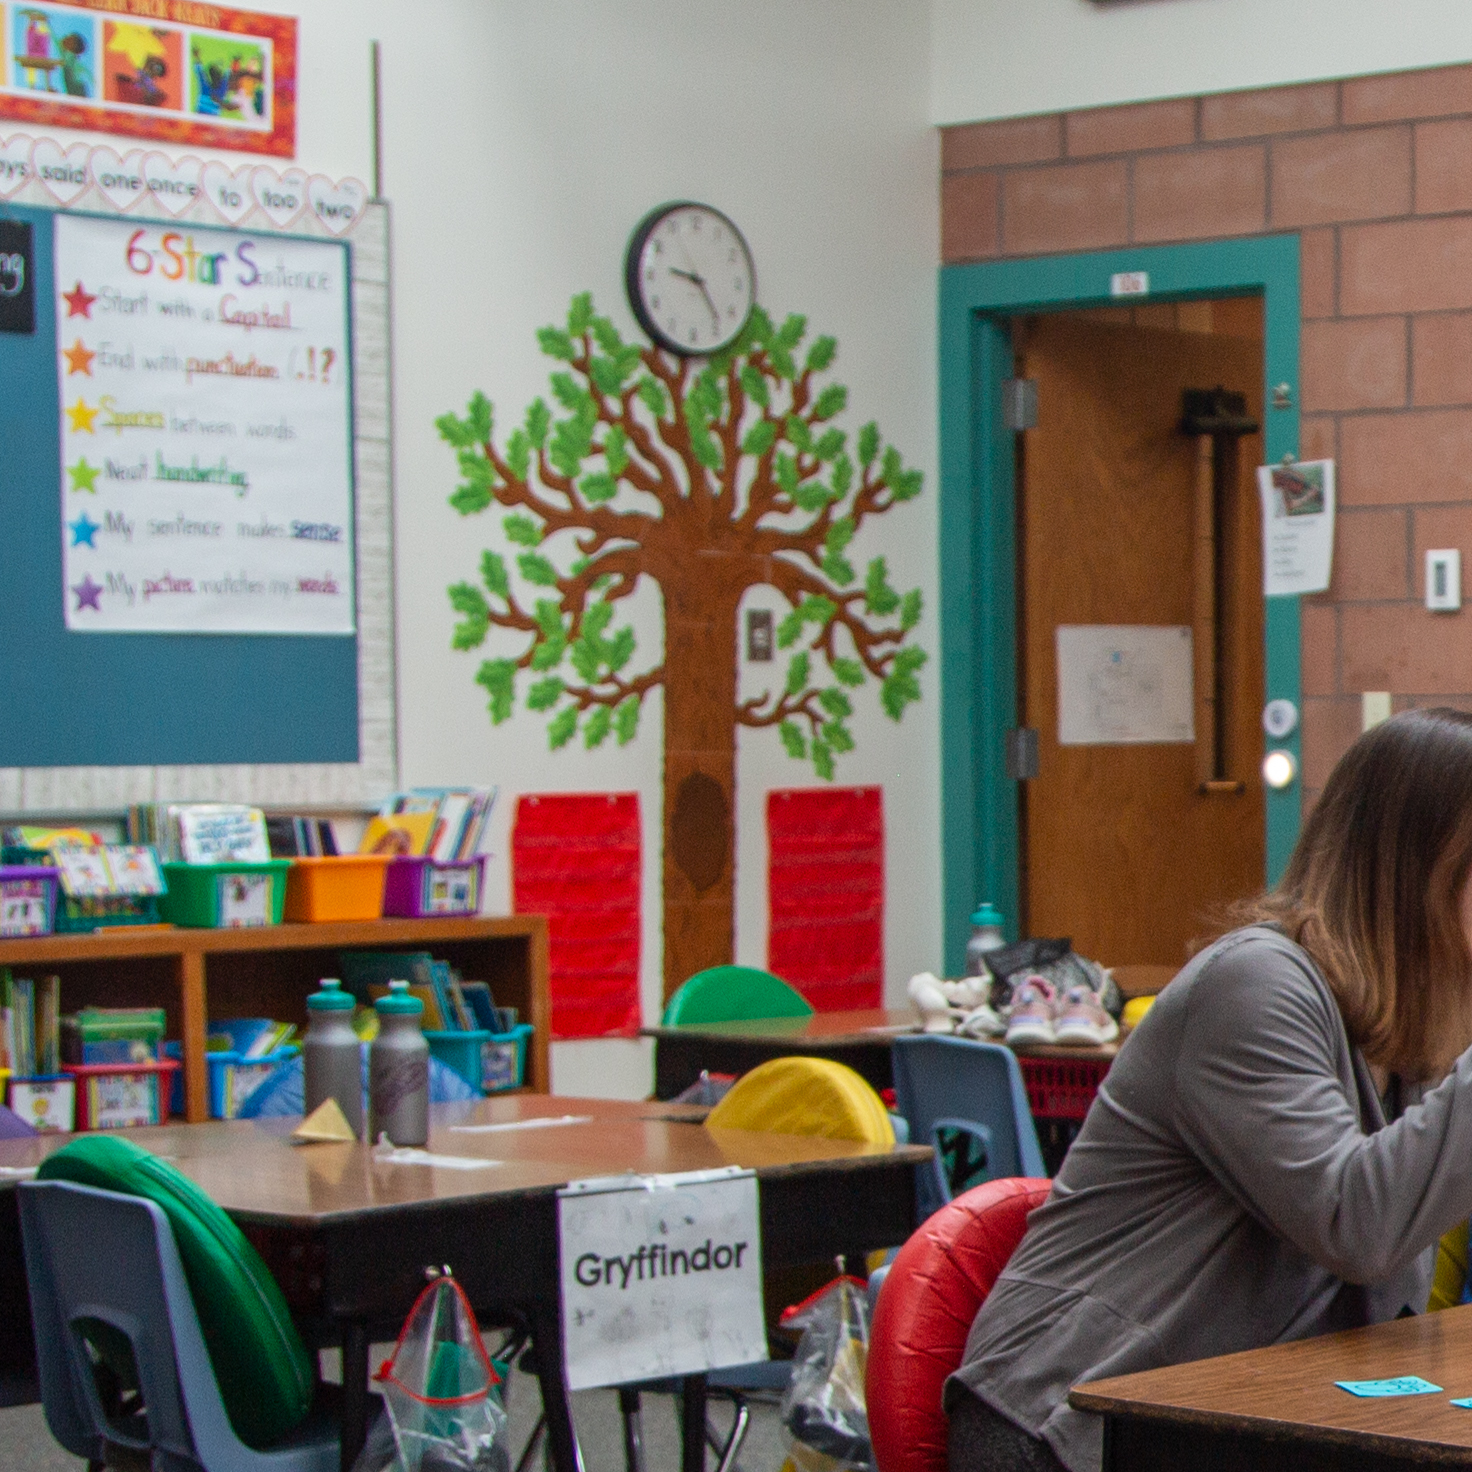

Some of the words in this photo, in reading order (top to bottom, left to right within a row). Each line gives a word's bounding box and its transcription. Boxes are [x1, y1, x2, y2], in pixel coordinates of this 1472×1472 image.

[41, 164, 87, 185] said
[101, 171, 142, 190] one
[147, 177, 198, 197] once
[219, 186, 242, 207] to
[262, 189, 298, 209] too
[315, 200, 356, 220] two
[218, 293, 292, 332] Capital
[574, 1239, 748, 1291] Gryffindor
